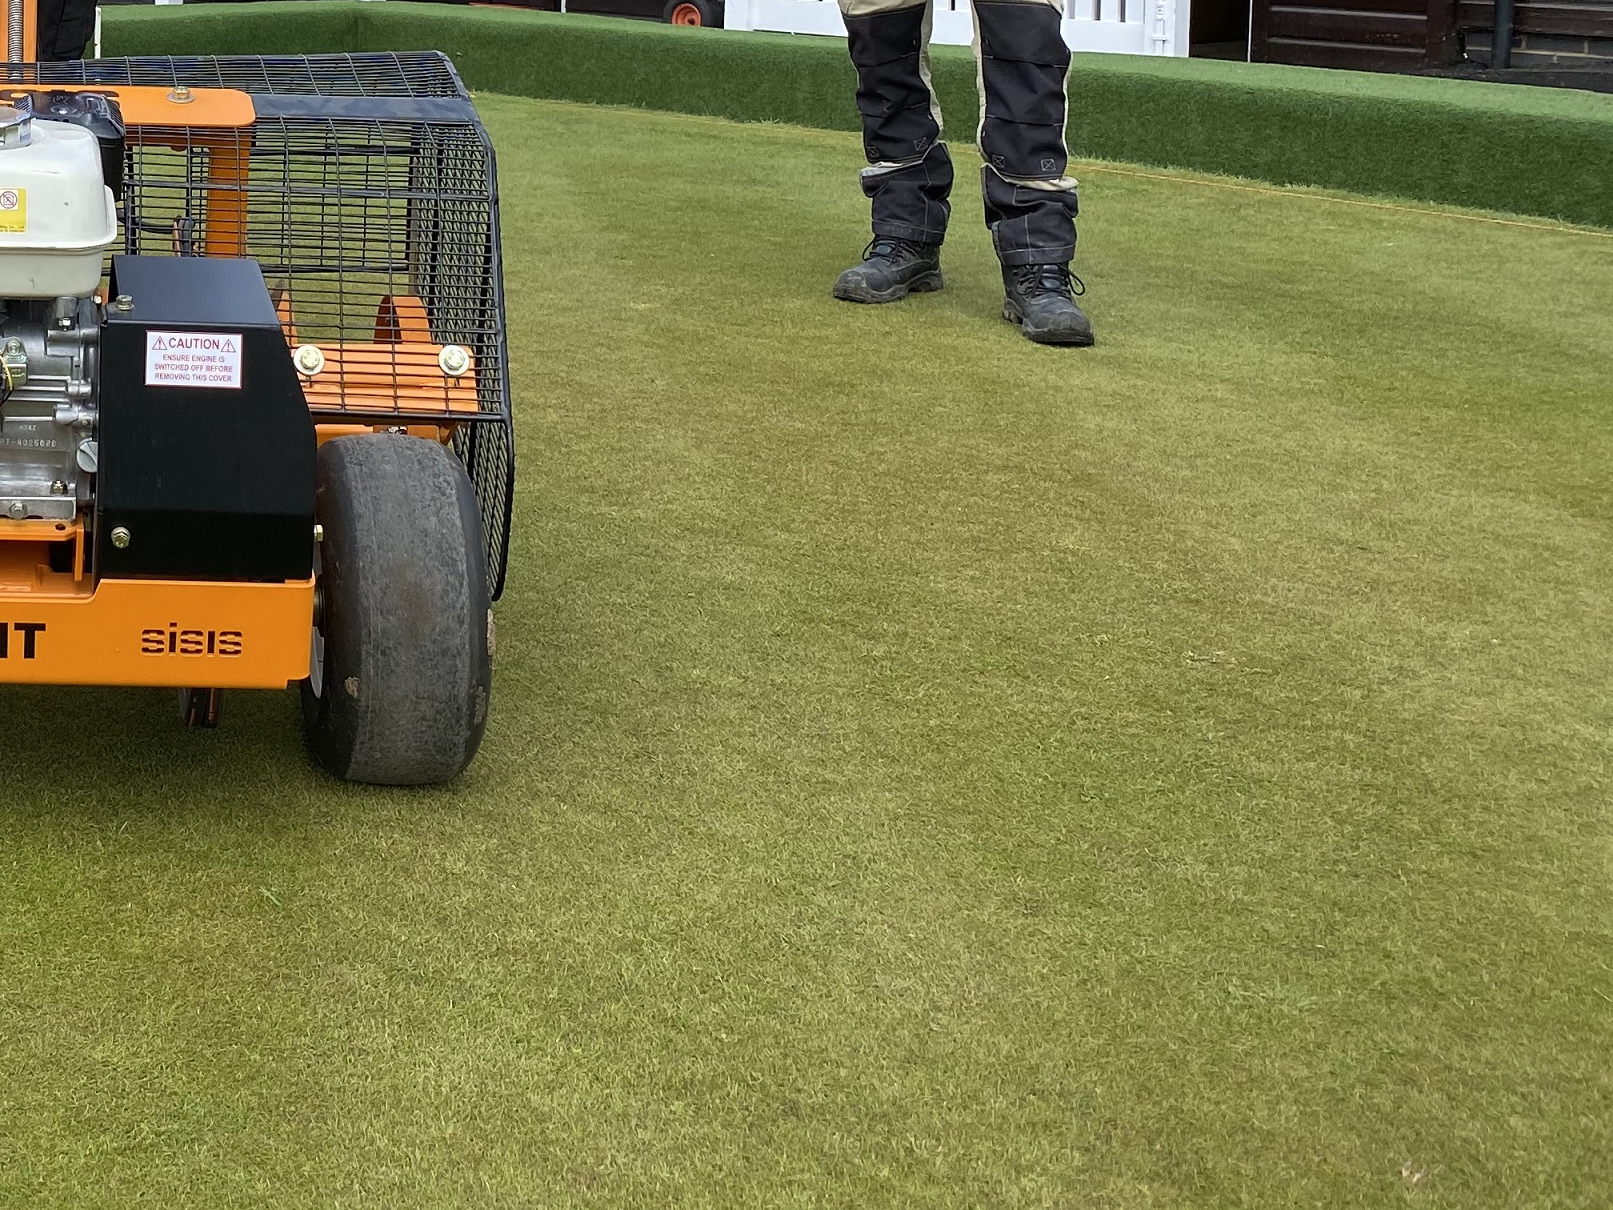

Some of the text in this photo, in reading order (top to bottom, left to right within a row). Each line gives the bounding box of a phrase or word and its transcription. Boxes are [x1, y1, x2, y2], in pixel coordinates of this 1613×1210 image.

[168, 337, 220, 350] CAUTION
[163, 354, 225, 363] ENSURE ENGINE IS
[154, 363, 189, 371] SWITCHED
[155, 373, 190, 381] REMOVING
[192, 374, 207, 382] THIS
